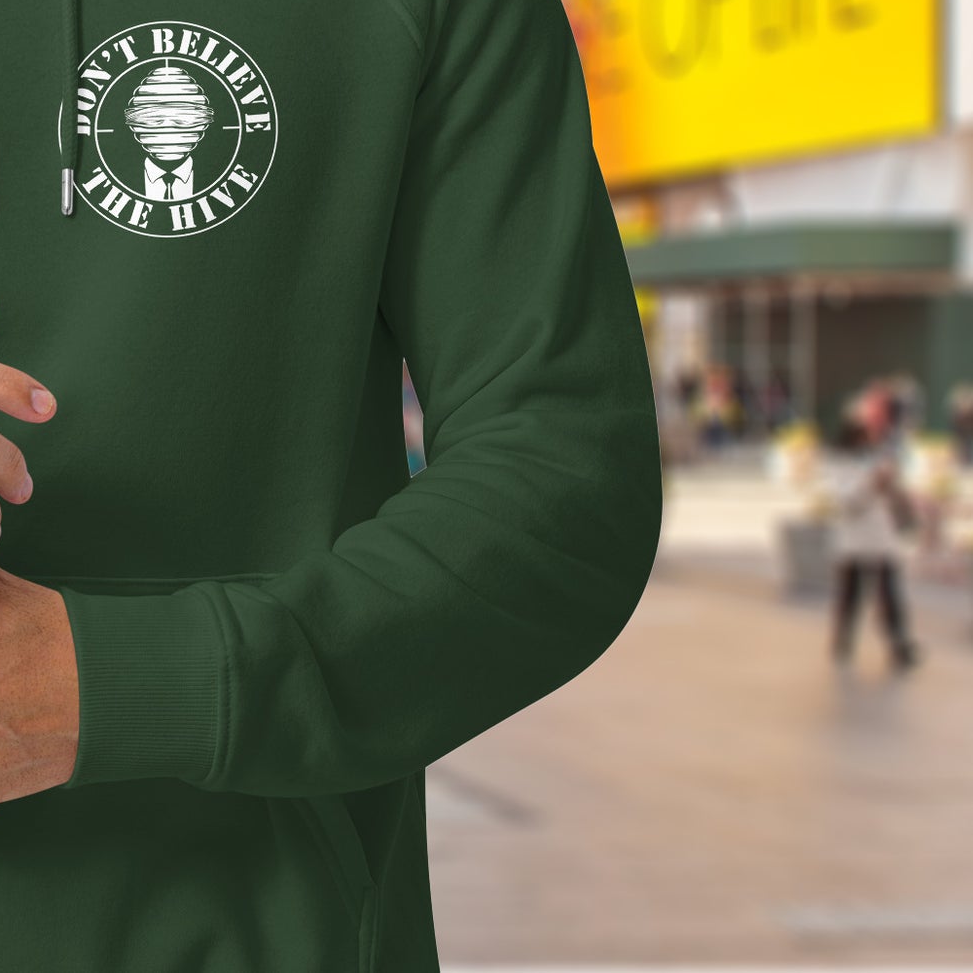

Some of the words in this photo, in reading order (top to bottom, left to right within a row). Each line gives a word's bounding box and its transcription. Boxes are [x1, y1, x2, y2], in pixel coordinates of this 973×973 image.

[151, 28, 272, 133] BELIEVE
[81, 166, 154, 229] THE
[168, 163, 259, 232] HIVE
